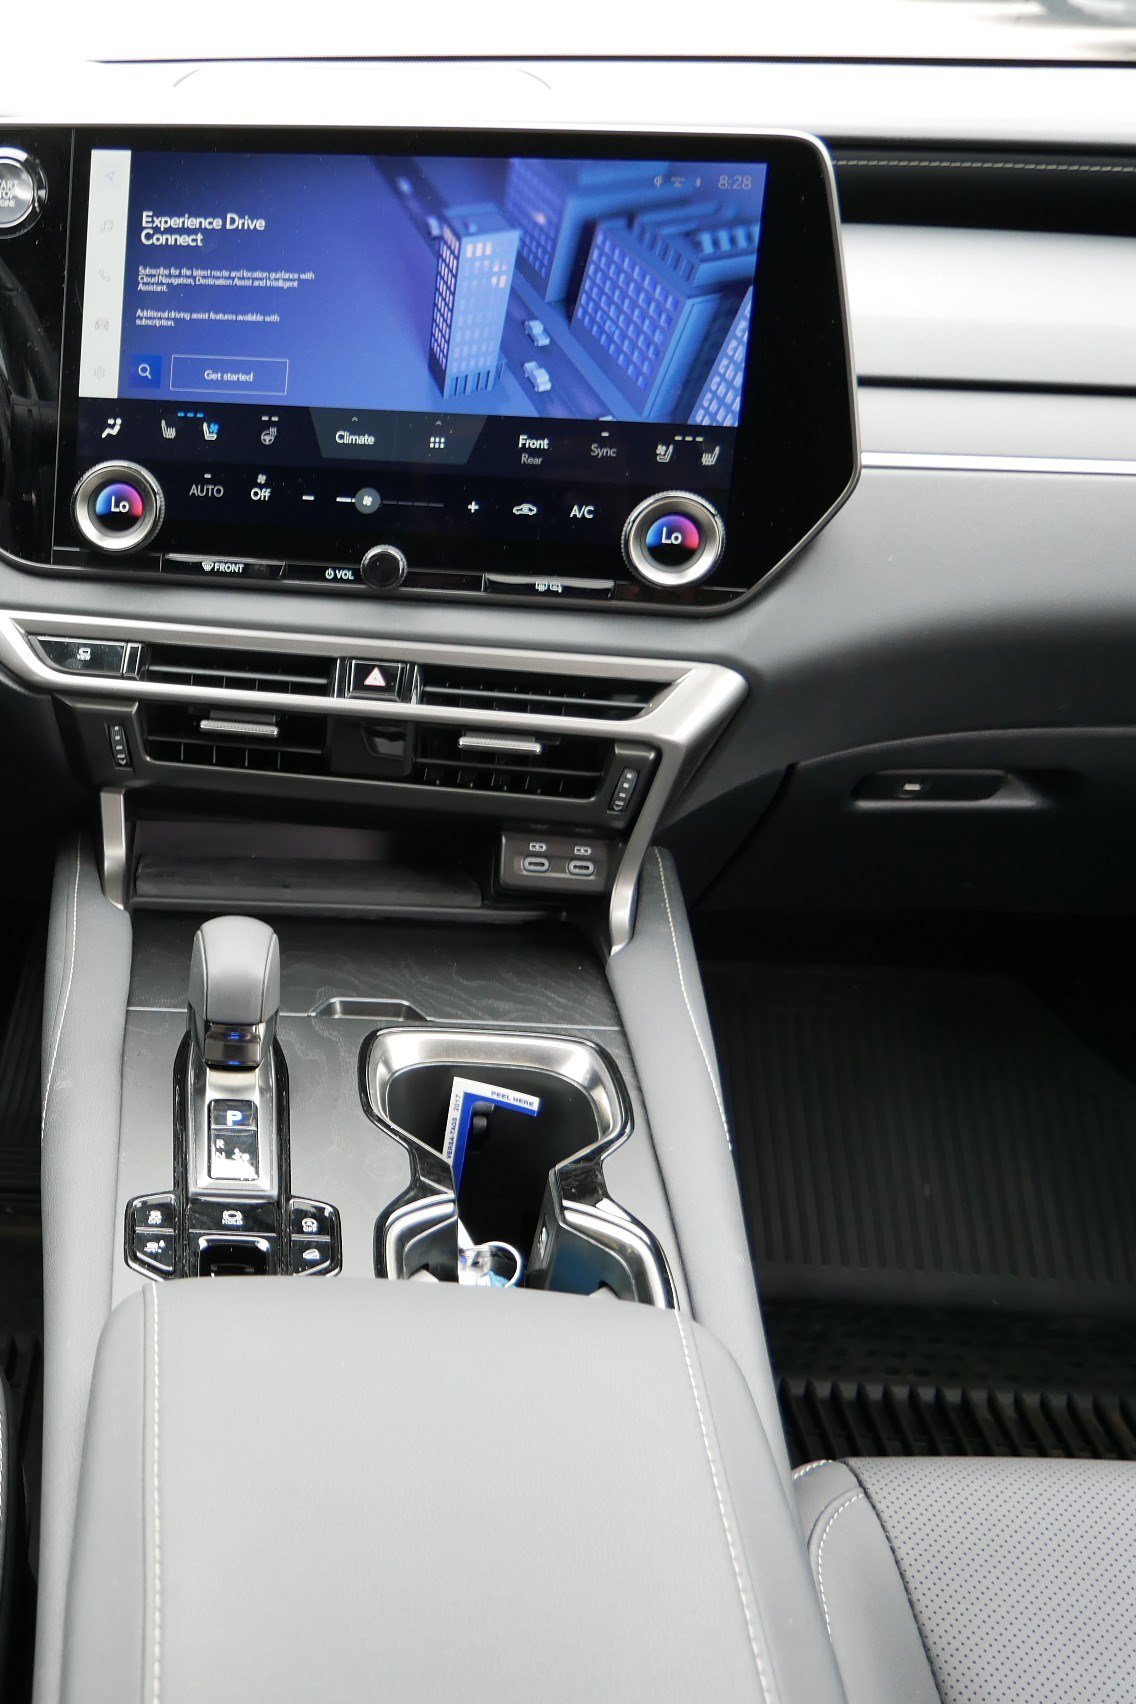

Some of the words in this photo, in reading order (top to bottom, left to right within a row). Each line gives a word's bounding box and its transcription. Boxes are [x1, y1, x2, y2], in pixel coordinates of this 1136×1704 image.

[718, 175, 752, 190] 8:28
[141, 211, 222, 231] Experience
[226, 213, 266, 231] Drive
[140, 229, 203, 246] Connect
[138, 265, 170, 275] Subscribe
[170, 267, 180, 275] for
[181, 267, 192, 276] the
[193, 267, 211, 277] latest
[211, 269, 230, 277] route
[230, 269, 243, 277] and
[244, 269, 269, 278] location
[269, 270, 299, 280] guidance
[300, 270, 315, 280] with
[138, 275, 158, 283] Cloud
[195, 276, 232, 286] Destination
[233, 277, 252, 287] Assist
[253, 279, 266, 287] and
[266, 279, 298, 289] Intelligent
[135, 308, 168, 318] Additional
[168, 310, 191, 320] driving
[191, 311, 209, 320] assist
[209, 311, 237, 321] features
[237, 312, 265, 322] available
[265, 313, 280, 322] with
[204, 370, 222, 381] Get
[223, 371, 253, 382] started
[335, 430, 375, 446] Climate
[518, 434, 549, 450] Front
[590, 443, 617, 459] Sync
[521, 453, 543, 465] Rear
[189, 484, 224, 498] AUTO
[250, 487, 271, 501] Off
[110, 495, 129, 513] Lo
[570, 505, 594, 519] A/C
[661, 526, 682, 545] Lo
[214, 562, 244, 574] FRONT
[335, 569, 355, 580] VOL
[490, 1090, 511, 1101] PEEL
[512, 1096, 535, 1108] HERE
[226, 1110, 243, 1127] P
[216, 1138, 225, 1149] R
[446, 1117, 458, 1159] VERSA-TAGS
